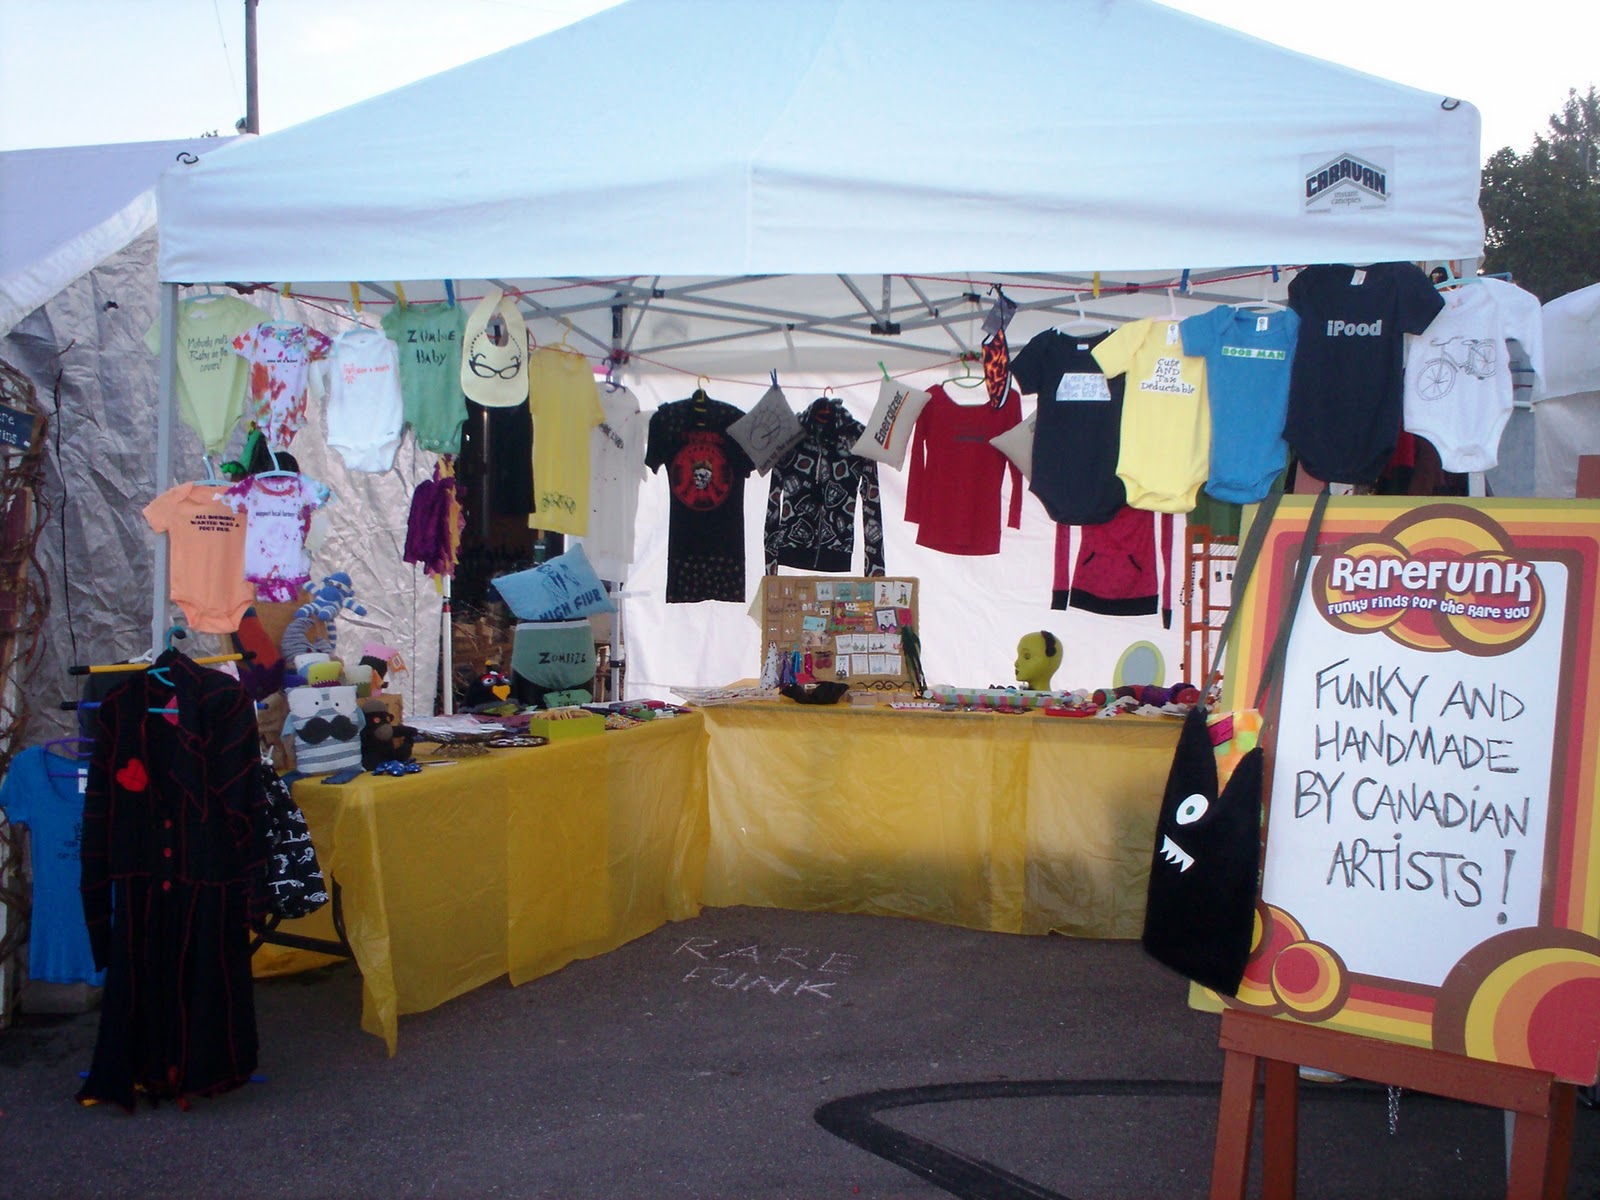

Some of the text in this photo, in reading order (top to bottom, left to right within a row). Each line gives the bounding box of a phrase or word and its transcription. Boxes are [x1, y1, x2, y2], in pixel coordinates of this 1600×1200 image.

[1306, 158, 1386, 198] CARAVAN
[1327, 319, 1382, 336] iPood
[1155, 366, 1180, 376] AND
[1156, 374, 1177, 384] Tax
[1157, 359, 1180, 367] Cute
[874, 391, 904, 446] Energizer
[1316, 658, 1524, 722] FUNKY AND
[1315, 720, 1520, 773] HANDMADE
[1295, 770, 1345, 824] BY
[672, 936, 858, 974] RARE
[682, 967, 837, 998] FUNK
